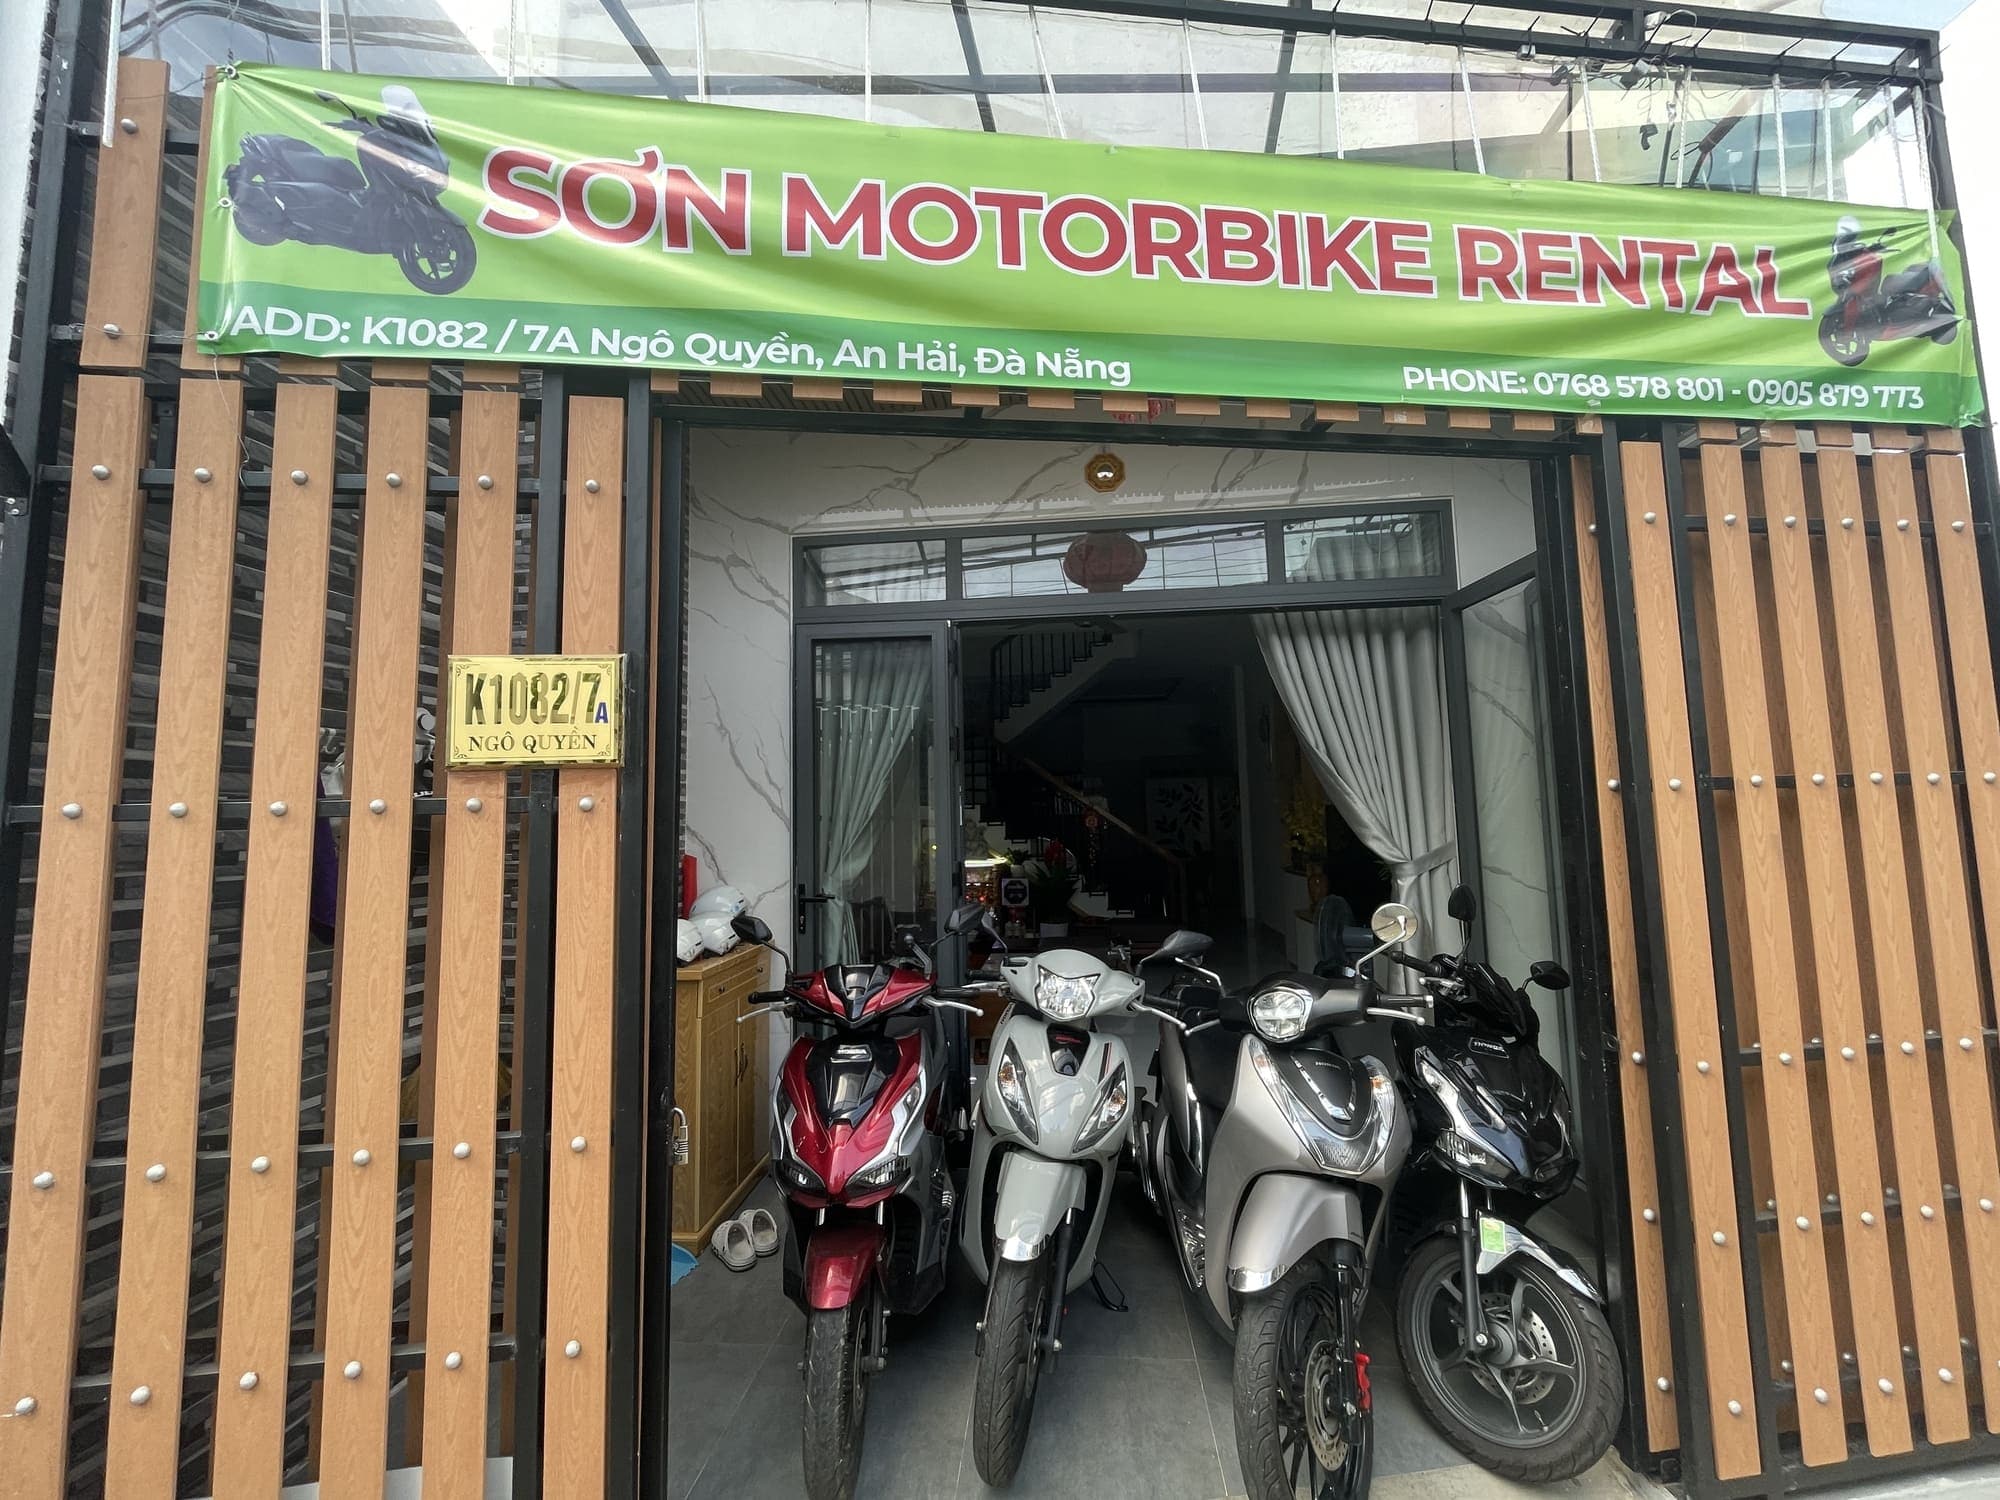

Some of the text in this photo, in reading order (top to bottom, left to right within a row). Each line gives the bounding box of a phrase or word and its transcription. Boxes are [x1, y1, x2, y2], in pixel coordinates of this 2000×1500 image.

[477, 146, 1813, 320] SƠN MOTORBIKE RENTAL
[229, 305, 1132, 387] ADD: K1082 / 7A Ngô Quyền, An Hải, Đà Nẵng
[1403, 366, 1925, 409] PHONE: 0768 578 801 - 0905 879 773
[469, 726, 598, 753] NGÔ QUYỀN
